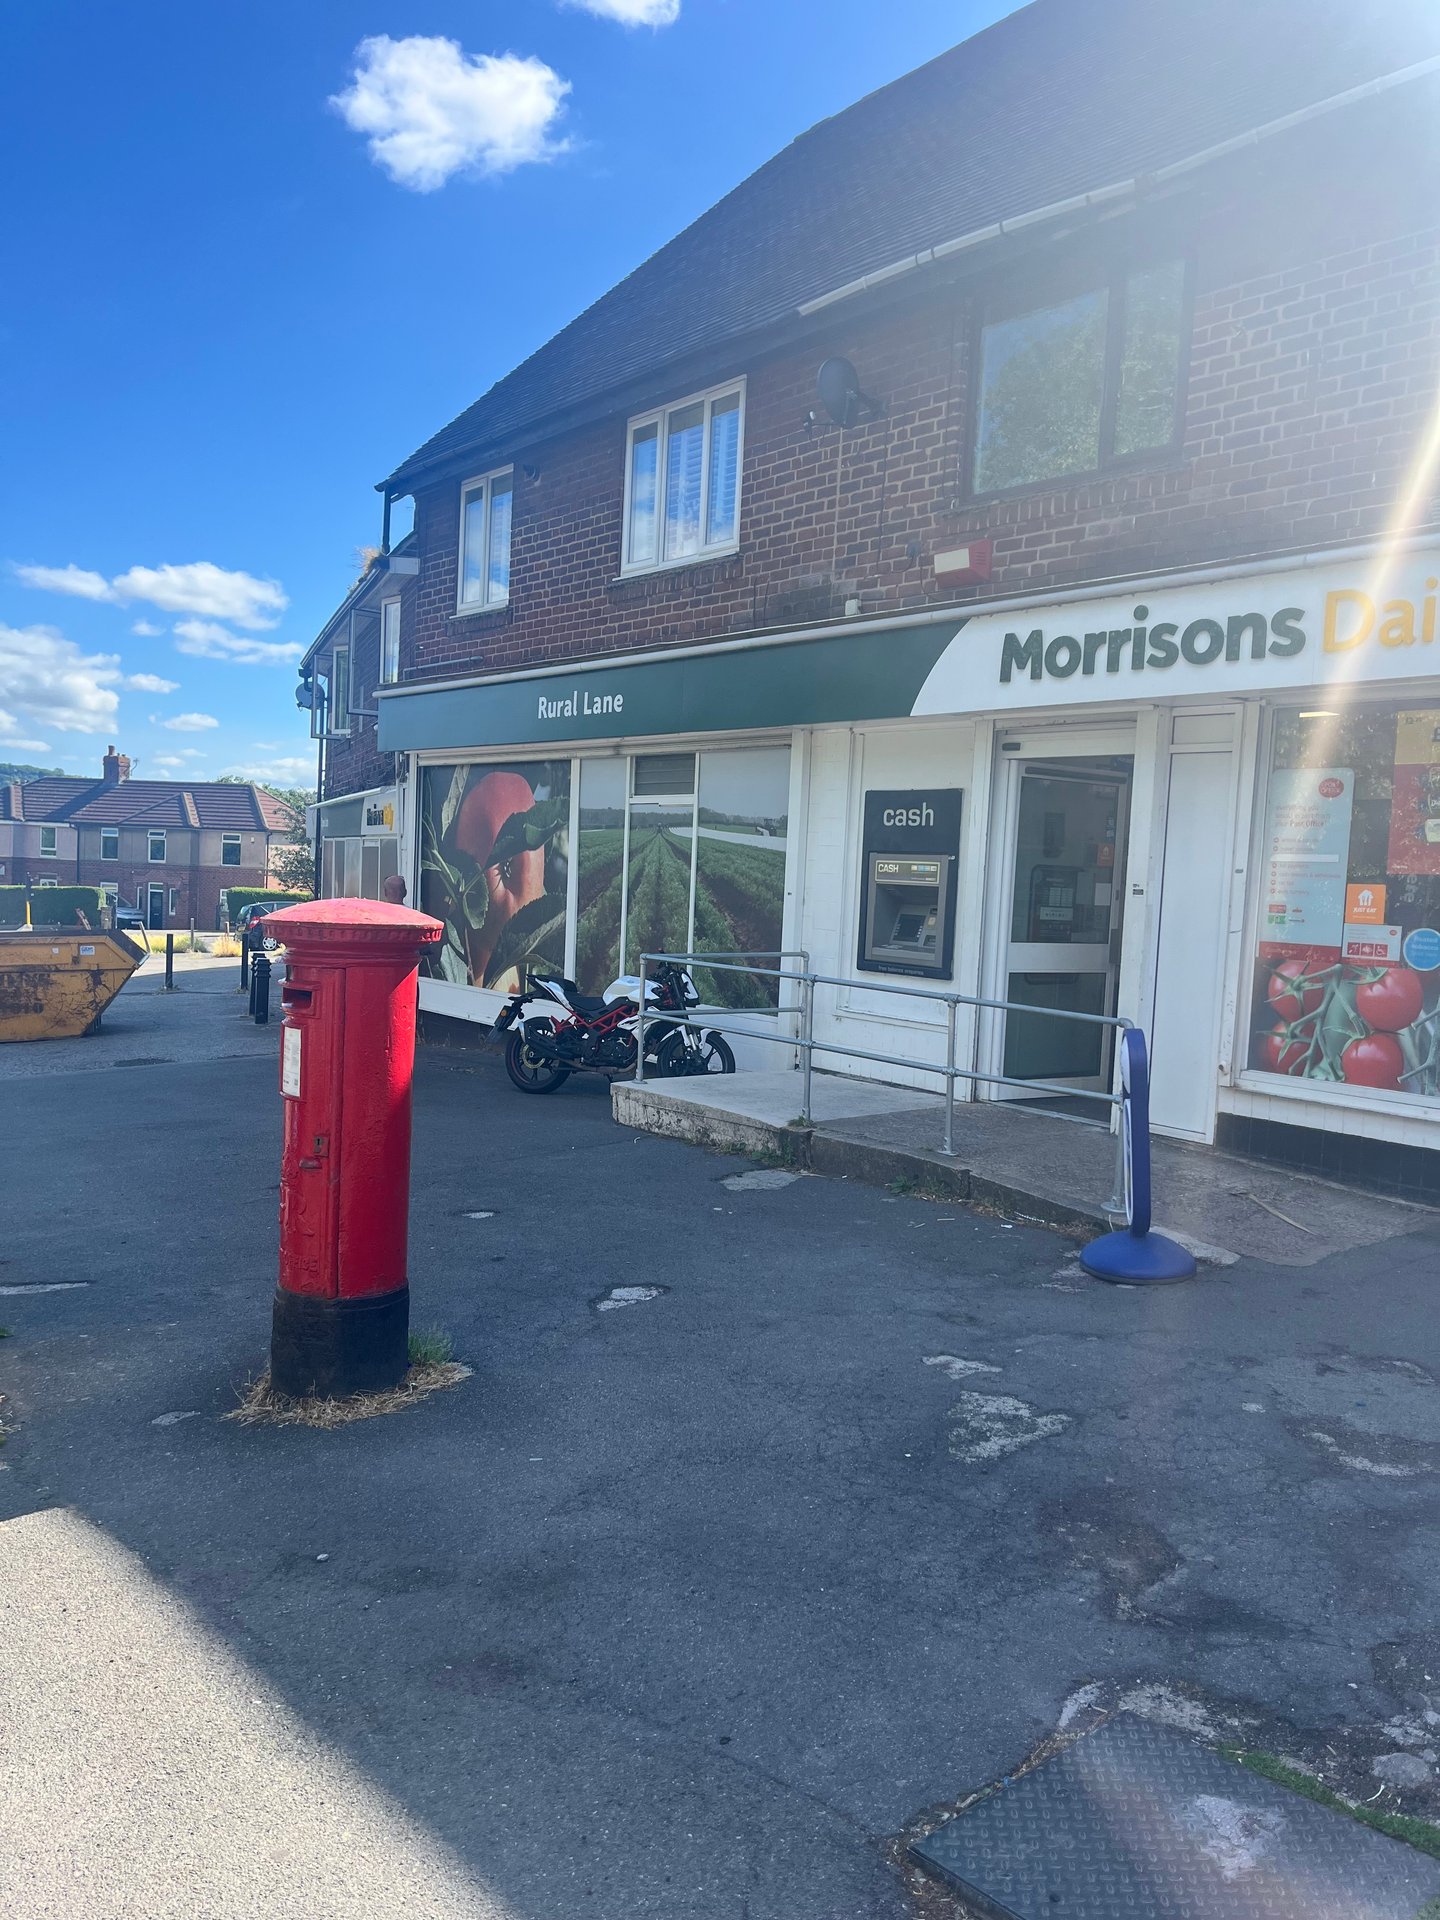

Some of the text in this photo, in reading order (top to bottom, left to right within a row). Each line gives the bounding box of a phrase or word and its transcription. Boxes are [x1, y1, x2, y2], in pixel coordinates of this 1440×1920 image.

[1000, 604, 1307, 683] Morrisons
[538, 690, 624, 719] Rural Lane
[883, 802, 934, 827] cash
[878, 863, 899, 873] CASH
